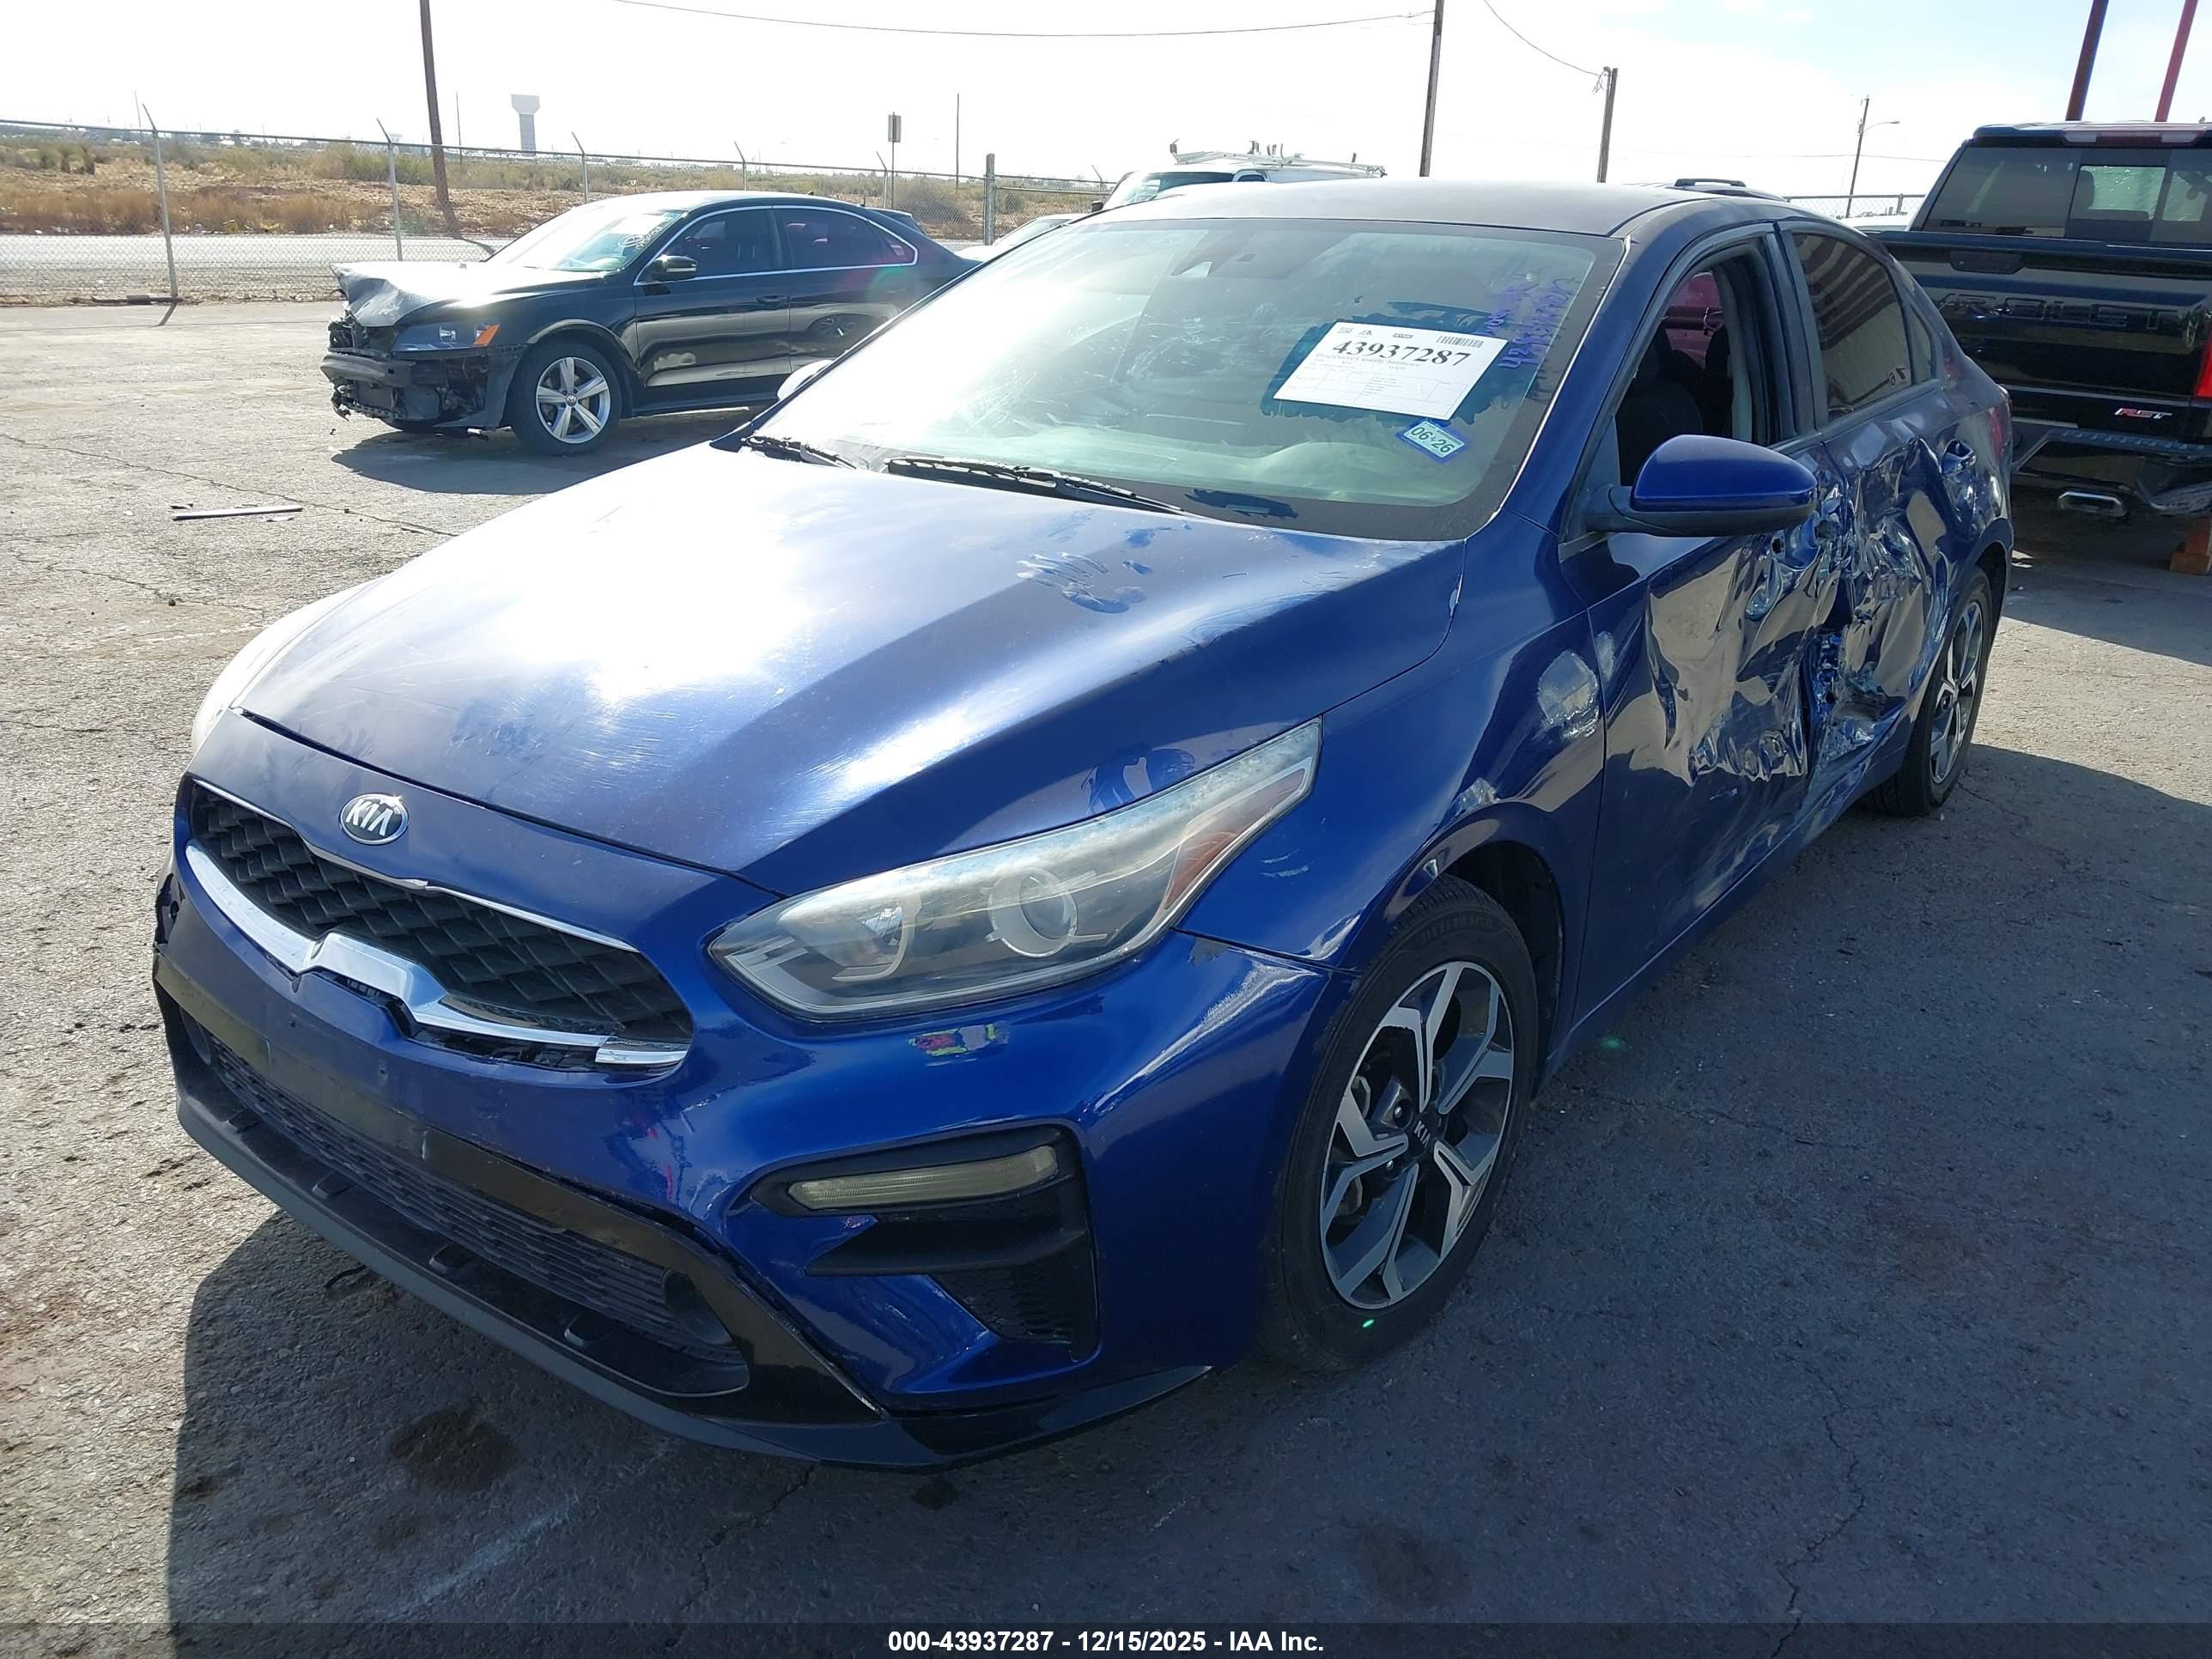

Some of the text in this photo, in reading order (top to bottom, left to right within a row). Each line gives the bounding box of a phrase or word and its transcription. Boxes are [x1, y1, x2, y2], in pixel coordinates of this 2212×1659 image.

[1332, 340, 1472, 368] 43937287
[2114, 408, 2173, 419] RST
[1411, 427, 1455, 453] 06 26
[345, 798, 394, 837] KIA
[1413, 1120, 1431, 1149] KIA
